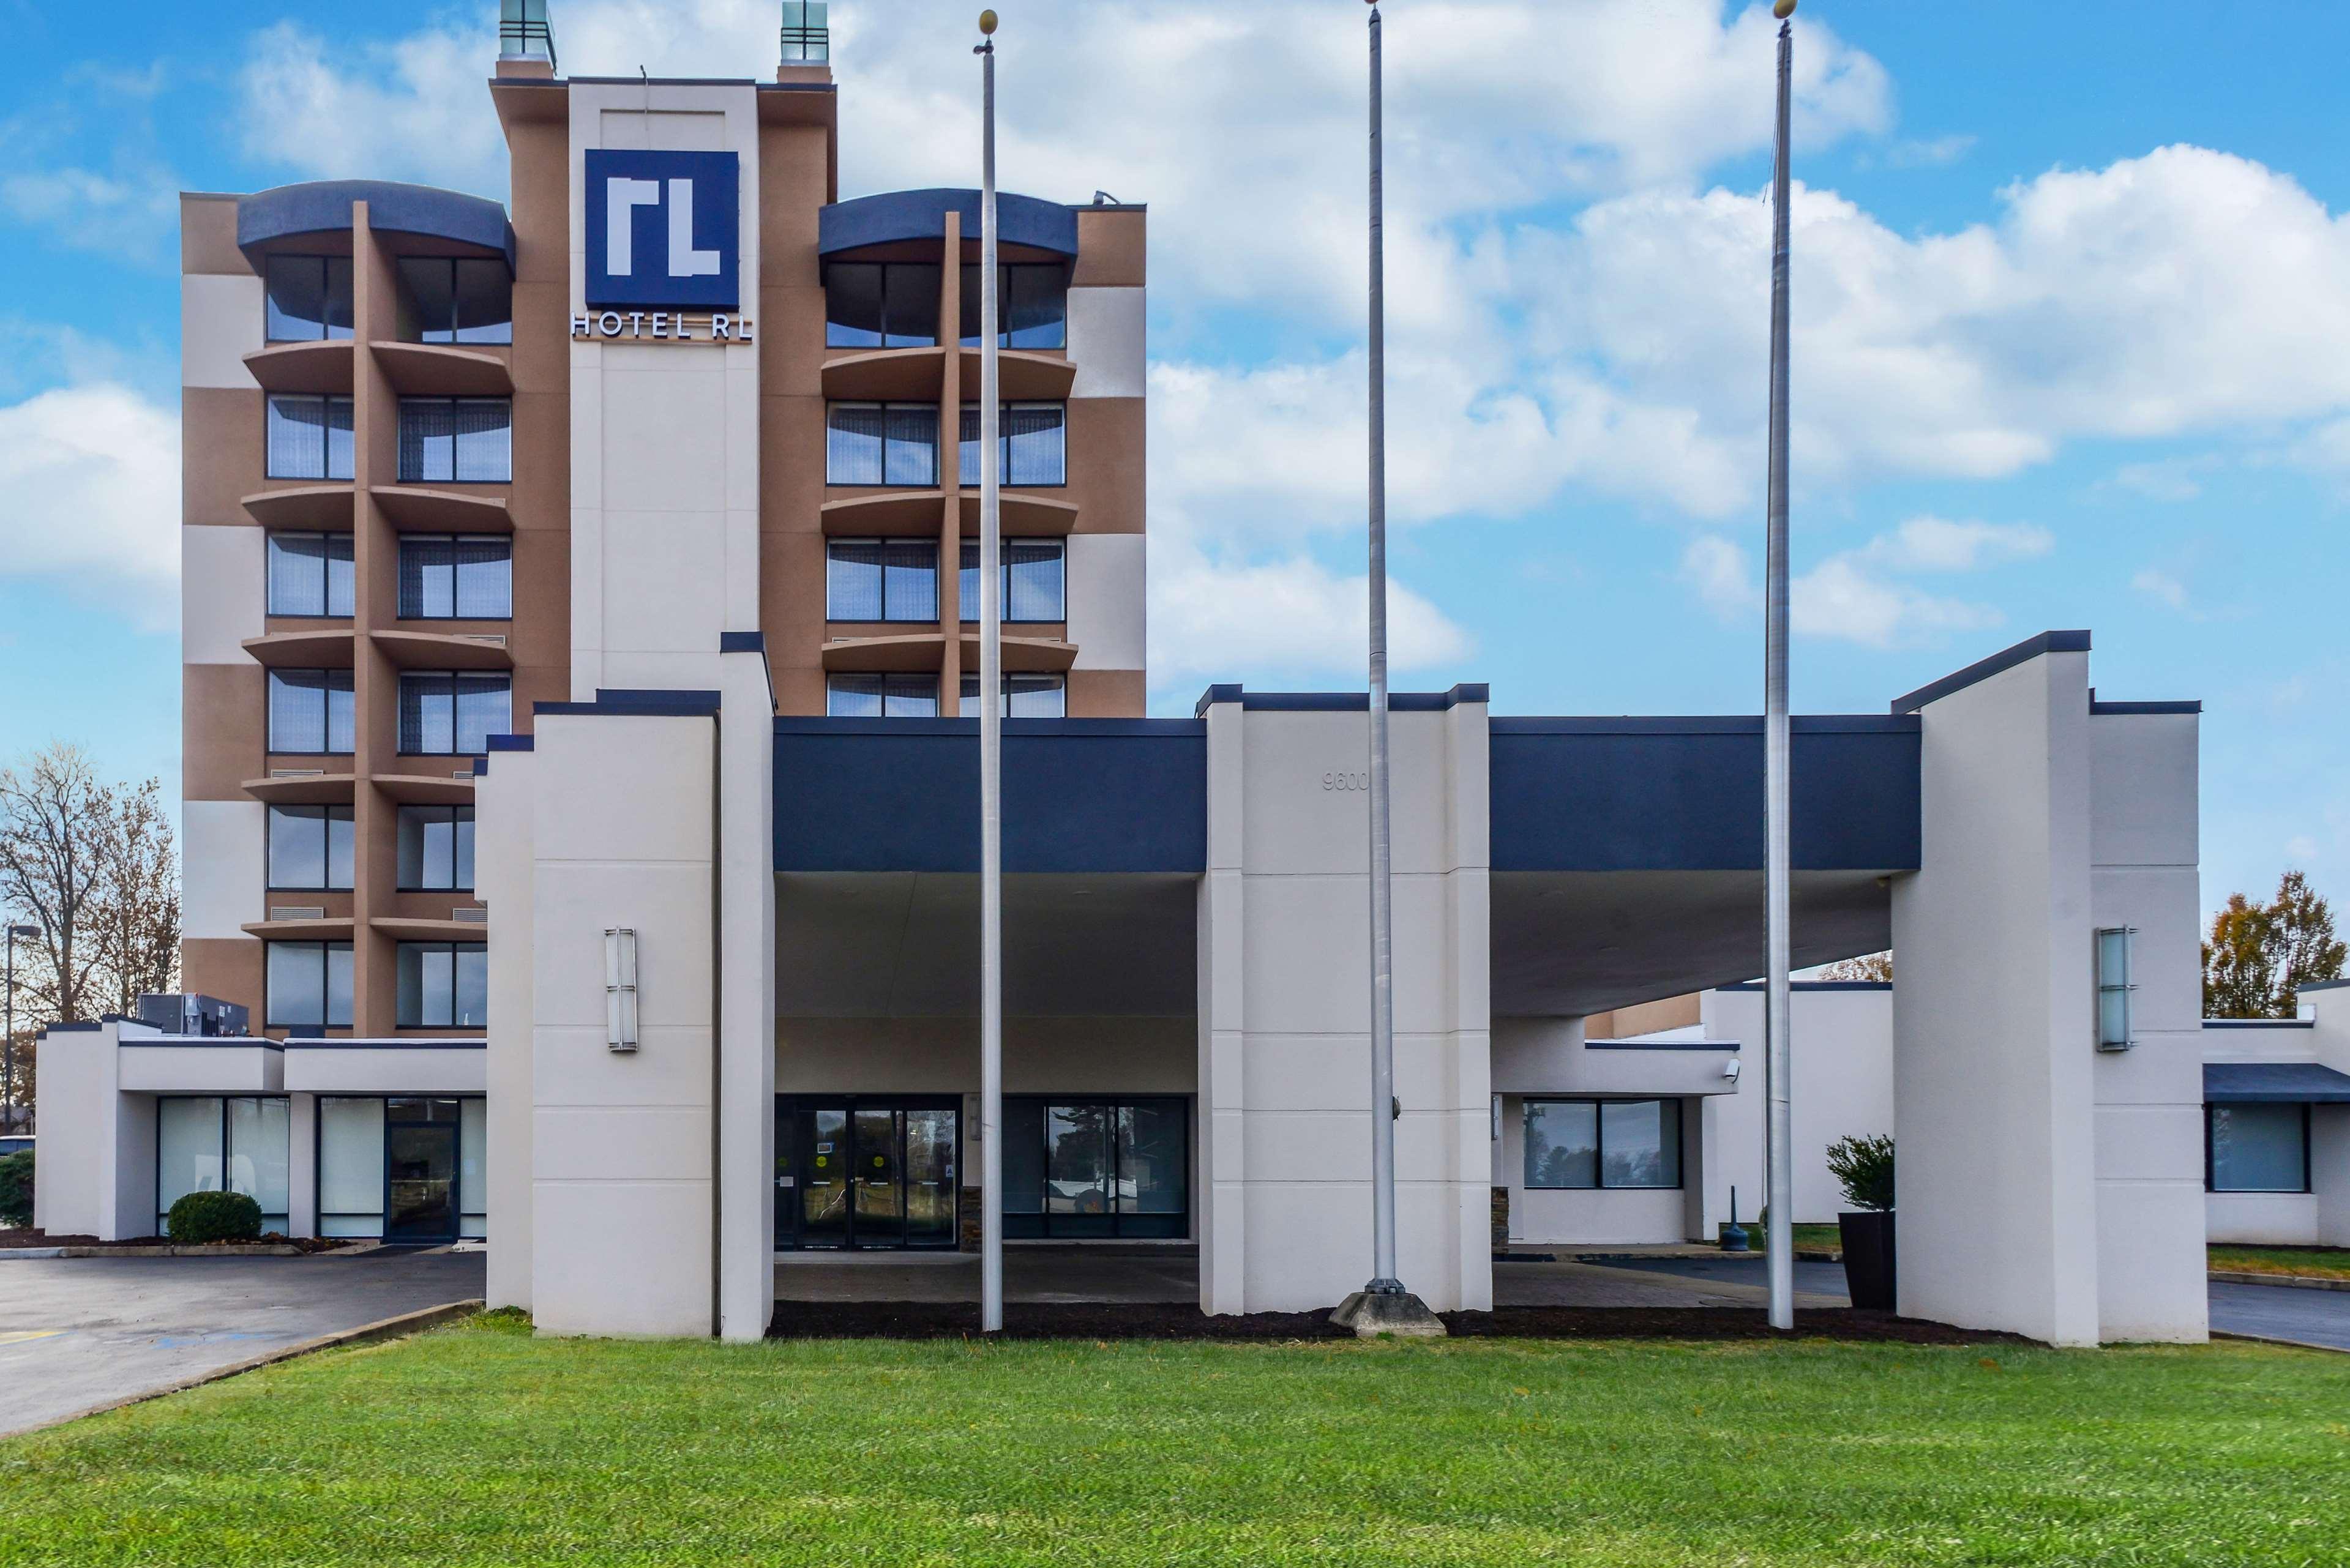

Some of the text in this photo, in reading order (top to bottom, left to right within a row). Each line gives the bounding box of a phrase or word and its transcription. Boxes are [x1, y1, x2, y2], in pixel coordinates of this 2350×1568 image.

[570, 311, 752, 339] HOTEL RL
[1322, 772, 1369, 791] 9600
